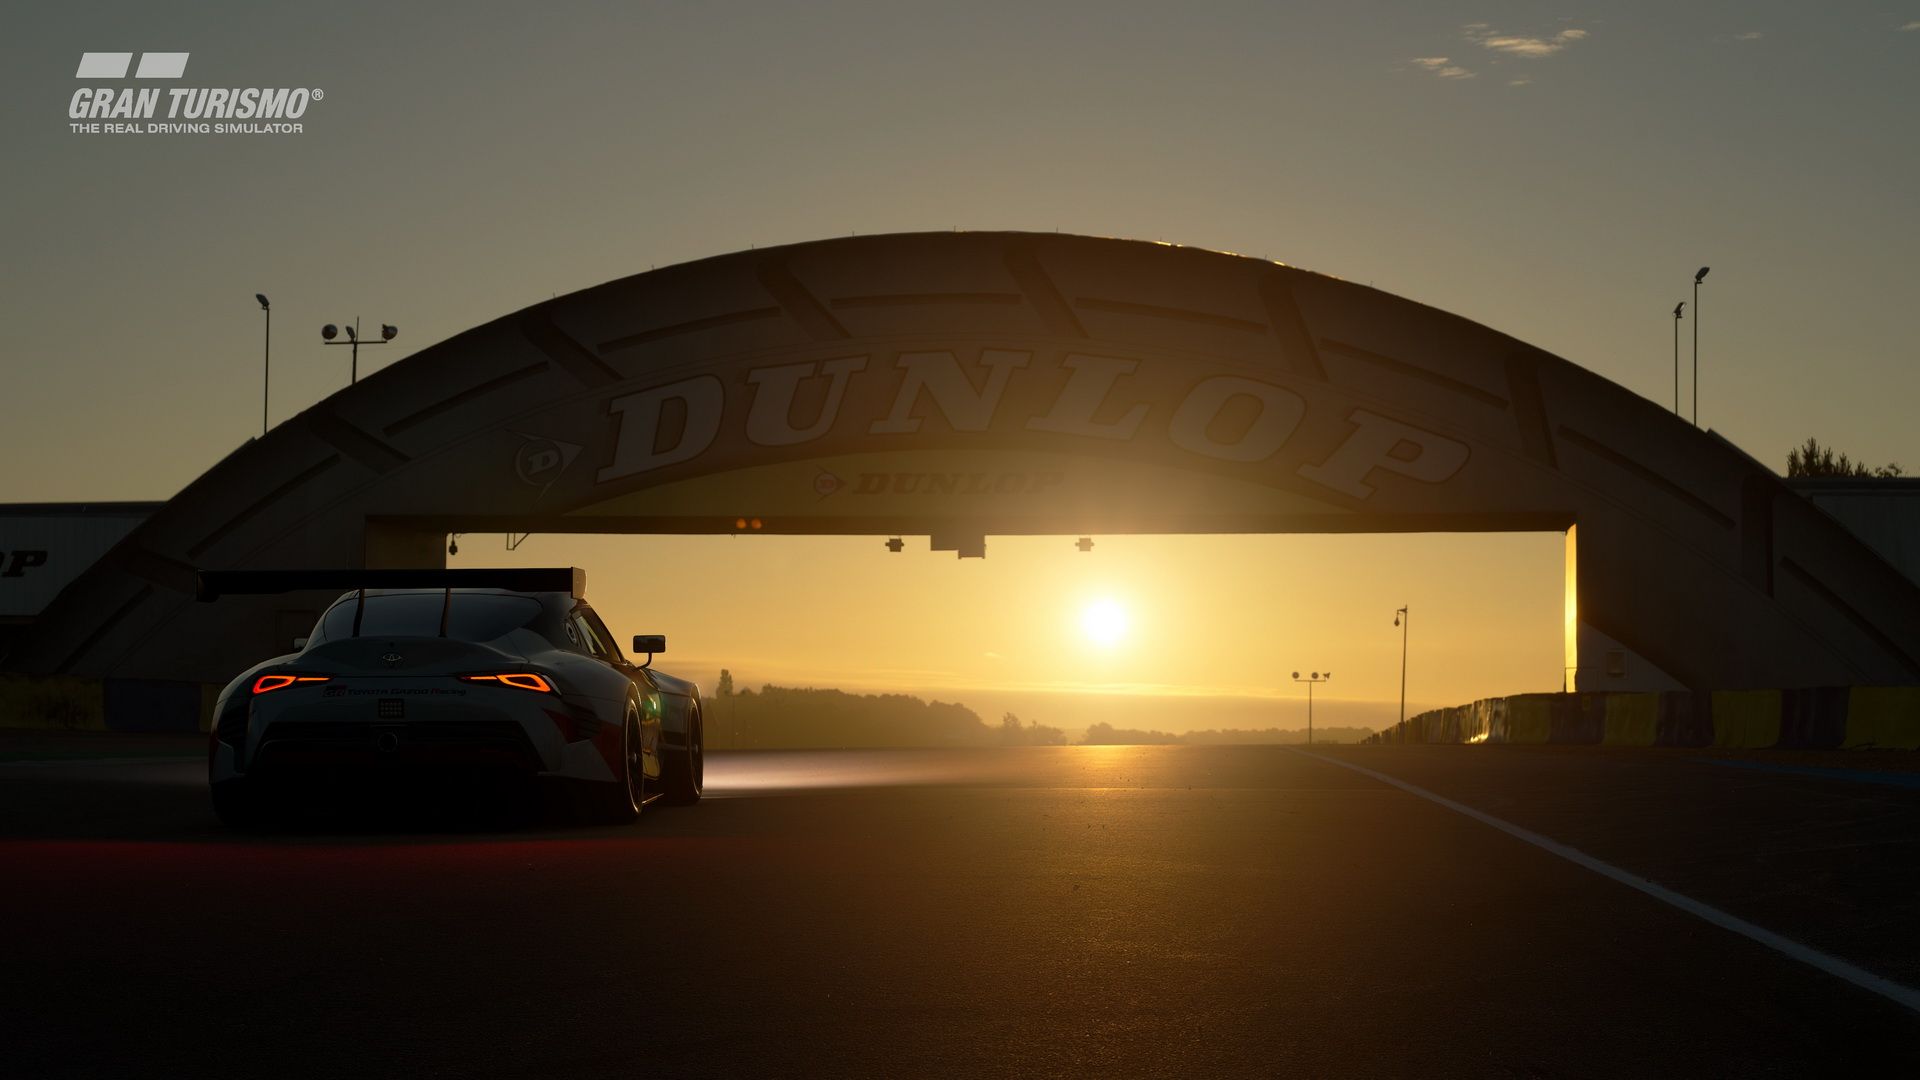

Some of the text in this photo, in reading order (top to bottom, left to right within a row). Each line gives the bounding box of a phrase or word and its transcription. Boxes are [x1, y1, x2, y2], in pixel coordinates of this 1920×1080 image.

[595, 349, 1473, 502] DUNLOP
[852, 472, 1066, 496] DUNLOP
[0, 550, 48, 577] P
